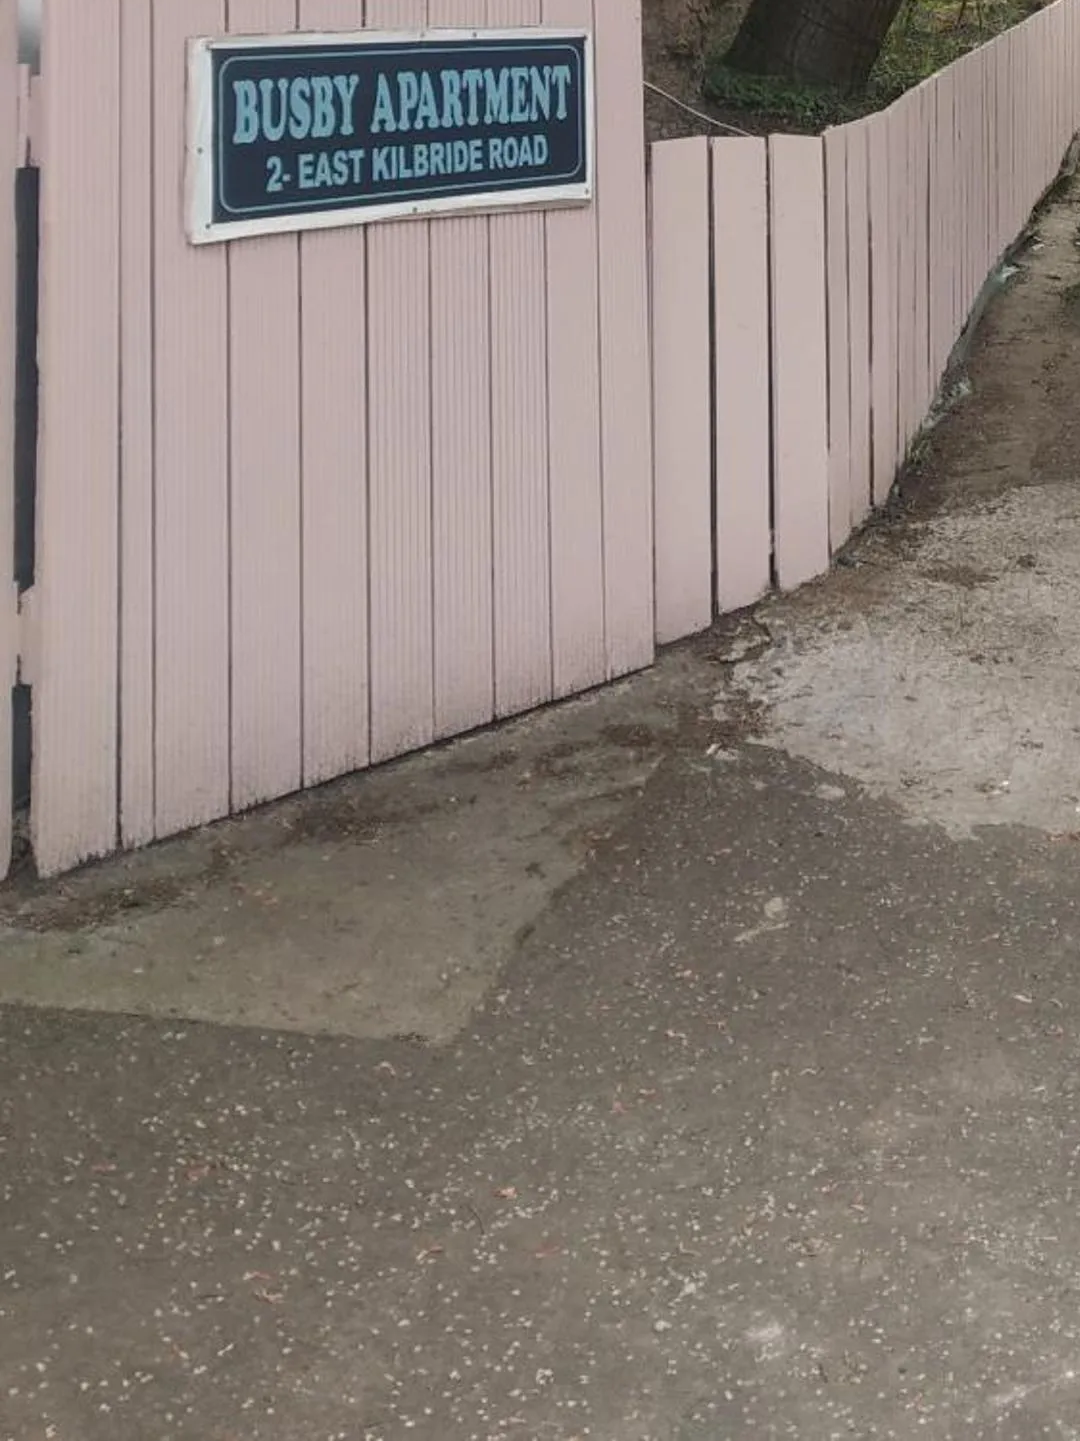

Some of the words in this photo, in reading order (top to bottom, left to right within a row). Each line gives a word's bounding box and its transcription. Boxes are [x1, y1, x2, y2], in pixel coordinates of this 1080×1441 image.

[233, 73, 359, 145] BUSBY
[370, 64, 572, 134] APARTMENT
[299, 150, 365, 190] EAST
[372, 140, 483, 182] KILBRIDE
[488, 134, 549, 168] ROAD
